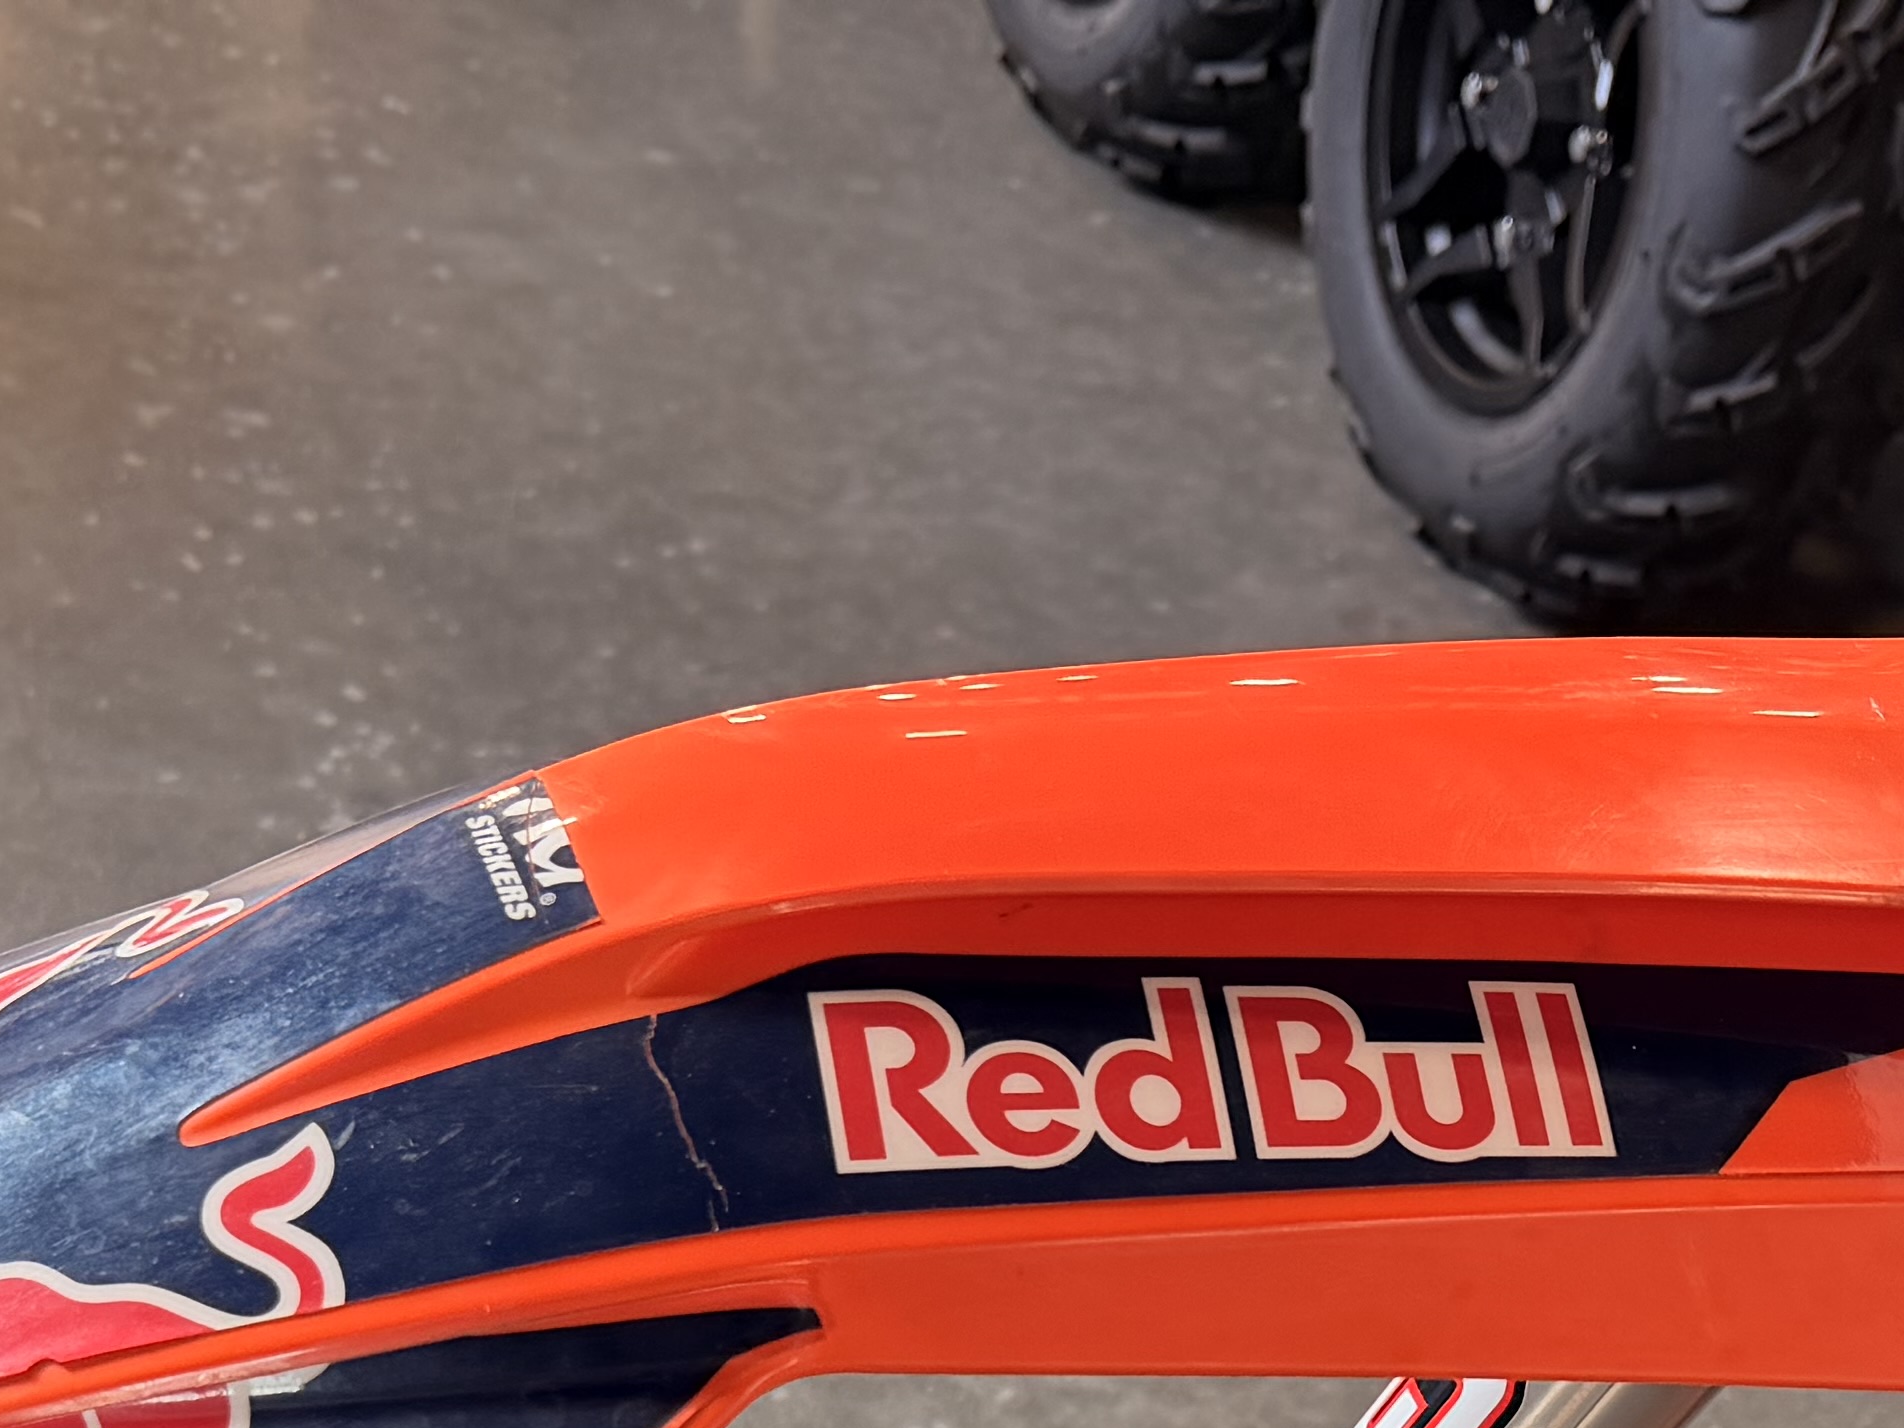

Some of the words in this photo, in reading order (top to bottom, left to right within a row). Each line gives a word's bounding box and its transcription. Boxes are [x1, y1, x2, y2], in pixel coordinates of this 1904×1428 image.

[464, 814, 537, 921] STICKERS
[808, 976, 1236, 1174] Red
[1223, 980, 1617, 1162] Bull
